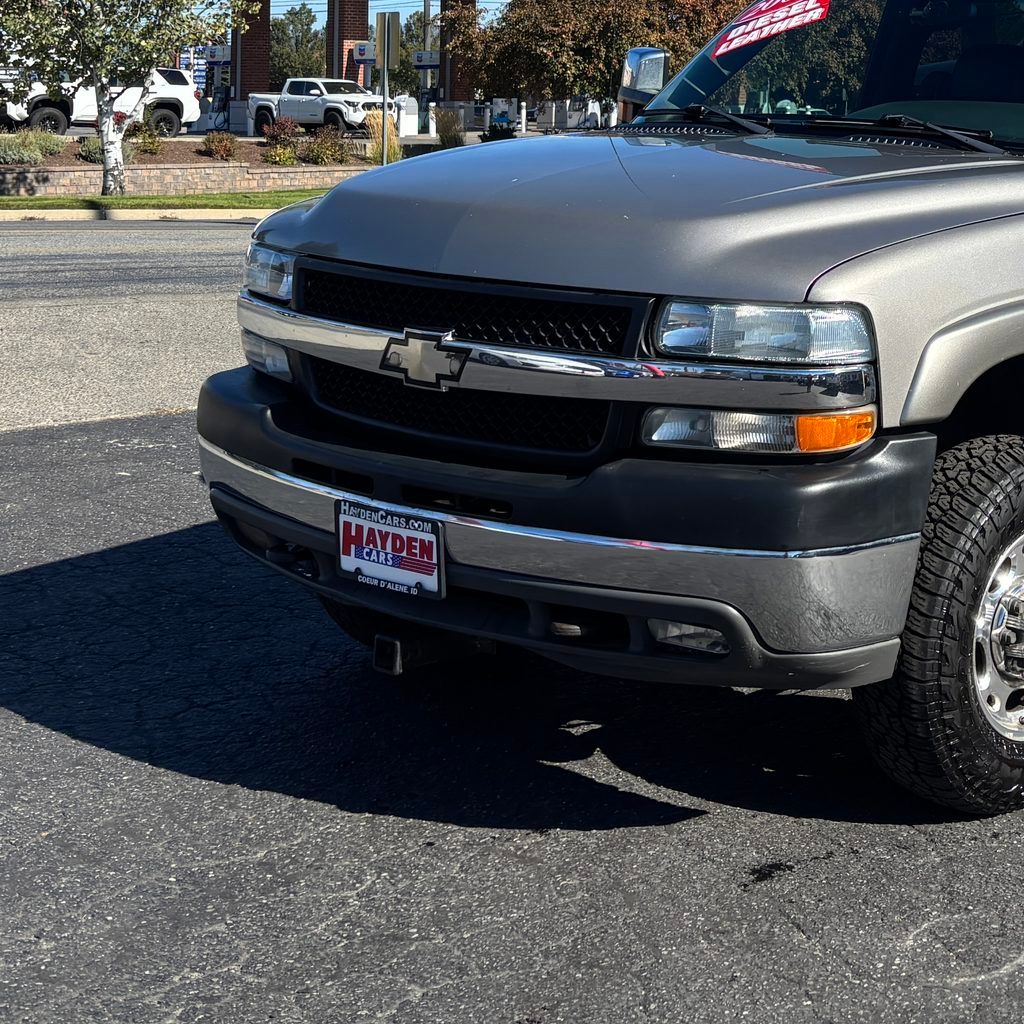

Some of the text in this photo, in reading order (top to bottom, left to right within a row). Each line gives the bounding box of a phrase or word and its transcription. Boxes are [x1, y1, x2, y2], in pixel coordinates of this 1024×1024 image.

[714, 7, 825, 57] LEATHER
[341, 520, 434, 562] HAYDEN
[363, 548, 393, 566] CARS
[357, 574, 379, 586] COEUR
[410, 586, 418, 595] ID
